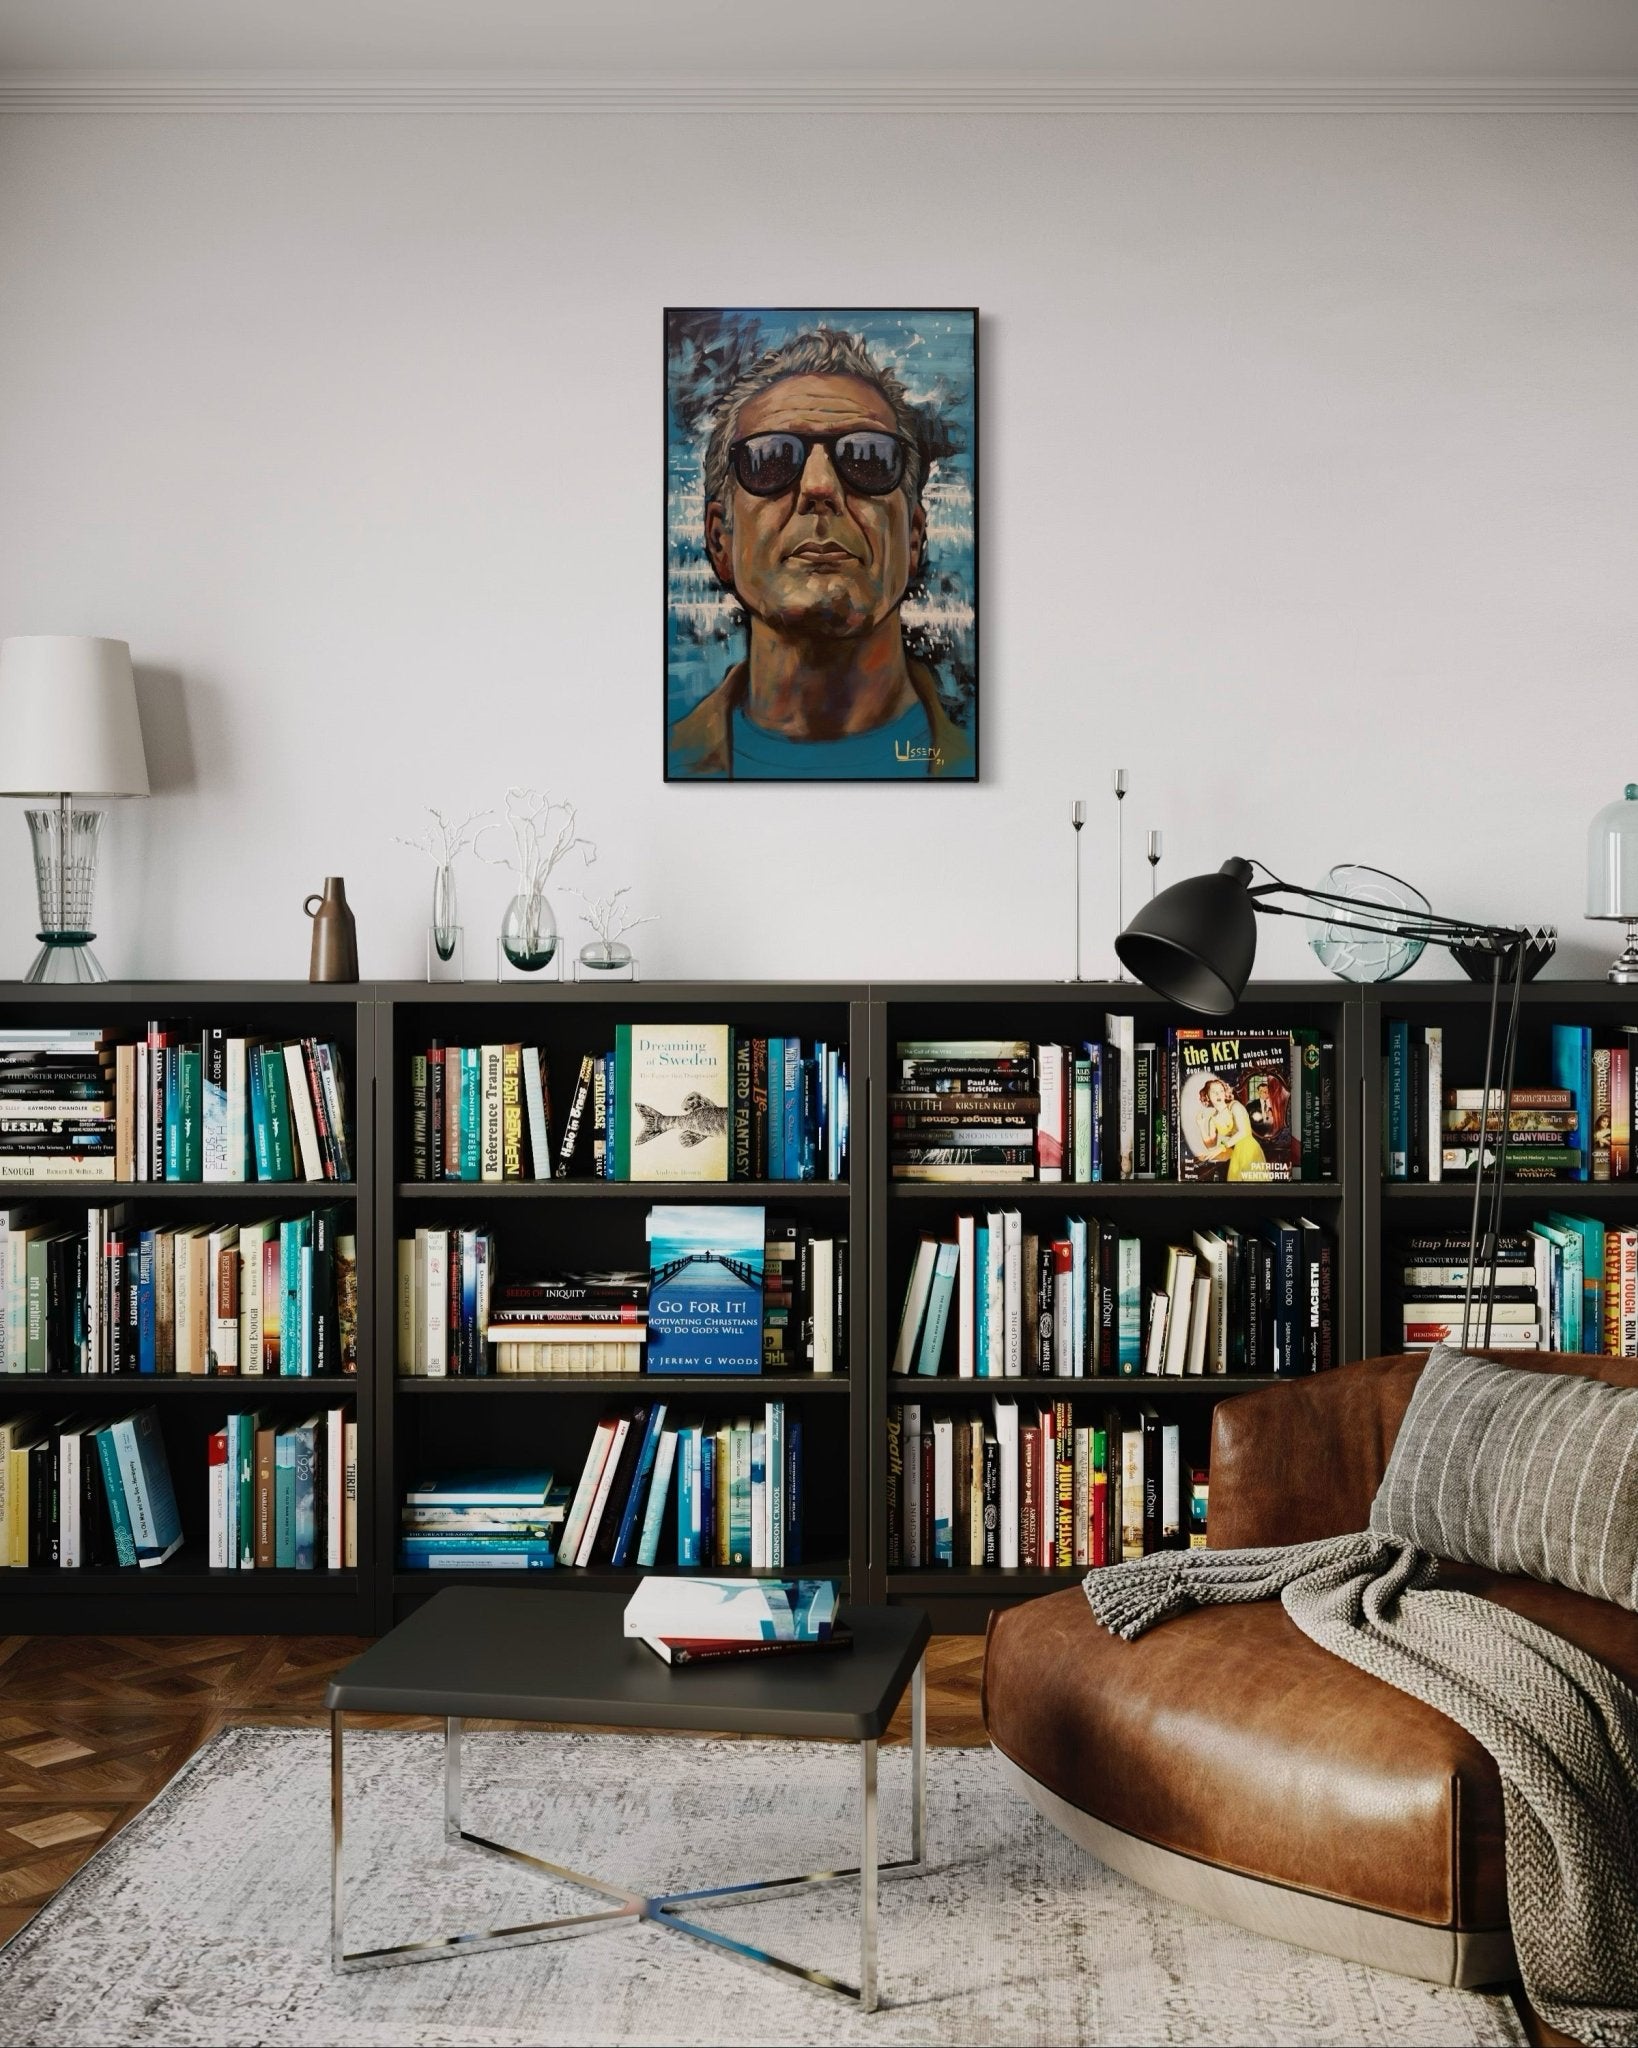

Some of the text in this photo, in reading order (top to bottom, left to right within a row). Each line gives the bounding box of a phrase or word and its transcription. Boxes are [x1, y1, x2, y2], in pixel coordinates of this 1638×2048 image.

[640, 1039, 706, 1052] Dreaming
[660, 1052, 717, 1066] Sweden
[1183, 1040, 1282, 1066] the KEY unlocks the
[213, 1050, 222, 1080] COBLEY
[924, 1066, 941, 1074] History
[968, 1066, 990, 1075] Astrology
[1138, 1057, 1148, 1077] THE
[1186, 1067, 1200, 1075] door
[1214, 1062, 1237, 1072] murder
[1240, 1060, 1253, 1069] and
[1256, 1057, 1284, 1067] violence
[1393, 1034, 1401, 1109] THE CAT IN THE HAT
[1593, 1048, 1611, 1112] Consuelo
[594, 1073, 606, 1130] STAIRCASE
[901, 1085, 930, 1093] Calling
[955, 1101, 1017, 1110] KIRSTEN KELLY
[967, 1085, 1003, 1093] Strickler
[1138, 1079, 1148, 1115] HOBBIT
[1512, 1094, 1568, 1104] BEETLEJUICE
[486, 1054, 499, 1173] Reference Tramp
[503, 1050, 521, 1175] THE PATH BETWEEN
[560, 1087, 588, 1158] Halo in Brass
[737, 1047, 749, 1176] WEIRD FANTASY
[921, 1116, 960, 1124] Games
[962, 1115, 1003, 1124] Hunger
[1303, 1090, 1312, 1154] Title your cover
[216, 1126, 227, 1170] EARTH
[414, 1087, 426, 1180] THIS WOMAN IS MINE
[1512, 1133, 1563, 1142] GANYMEDE
[205, 1137, 216, 1170] SEEDS
[1251, 1162, 1289, 1171] PATRICIA
[1529, 1154, 1545, 1162] History
[2, 1167, 35, 1176] ENOUGH
[1241, 1171, 1290, 1180] WENTWORTH
[1410, 1238, 1442, 1251] kitap
[222, 1255, 230, 1309] BEETLEJUICE
[402, 1275, 410, 1308] PRETEND
[506, 1289, 530, 1297] SEEDS
[546, 1289, 586, 1299] INIQUITY
[1284, 1238, 1294, 1344] THE KING'S BLOOD SABRINA
[1310, 1262, 1320, 1328] MACBETH
[1604, 1232, 1621, 1357] PLAY IT HARD
[1624, 1250, 1637, 1340] RUN TOUGH, RUN
[30, 1276, 41, 1341] arts architecture
[649, 1318, 758, 1326] MOTIVATING CHRISTIANS
[657, 1300, 746, 1313] GO FOR IT!
[1103, 1286, 1113, 1328] INIQUITY
[1249, 1274, 1257, 1366] THE PORTER PRINCIPLES
[1321, 1247, 1330, 1370] THE SNOWS GANYMEDE
[248, 1308, 258, 1371] ROUGH ENOUGH
[692, 1326, 719, 1334] GOD'S
[722, 1327, 744, 1335] WILL
[660, 1357, 758, 1366] JEREMY G WOODS
[765, 1351, 788, 1366] THE
[1043, 1340, 1051, 1372] HARPER LEE
[735, 1438, 743, 1459] Robinson
[886, 1421, 901, 1508] Death WISH
[297, 1454, 309, 1481] 1929
[346, 1463, 357, 1501] THRIFT
[261, 1487, 269, 1522] CHARLOTTE
[1146, 1477, 1155, 1518] INIQUITY
[773, 1486, 781, 1566] ROBINSON CRUSOE
[1020, 1507, 1029, 1555] HOGWARTS
[1058, 1464, 1073, 1567] MYSTERY BOOK
